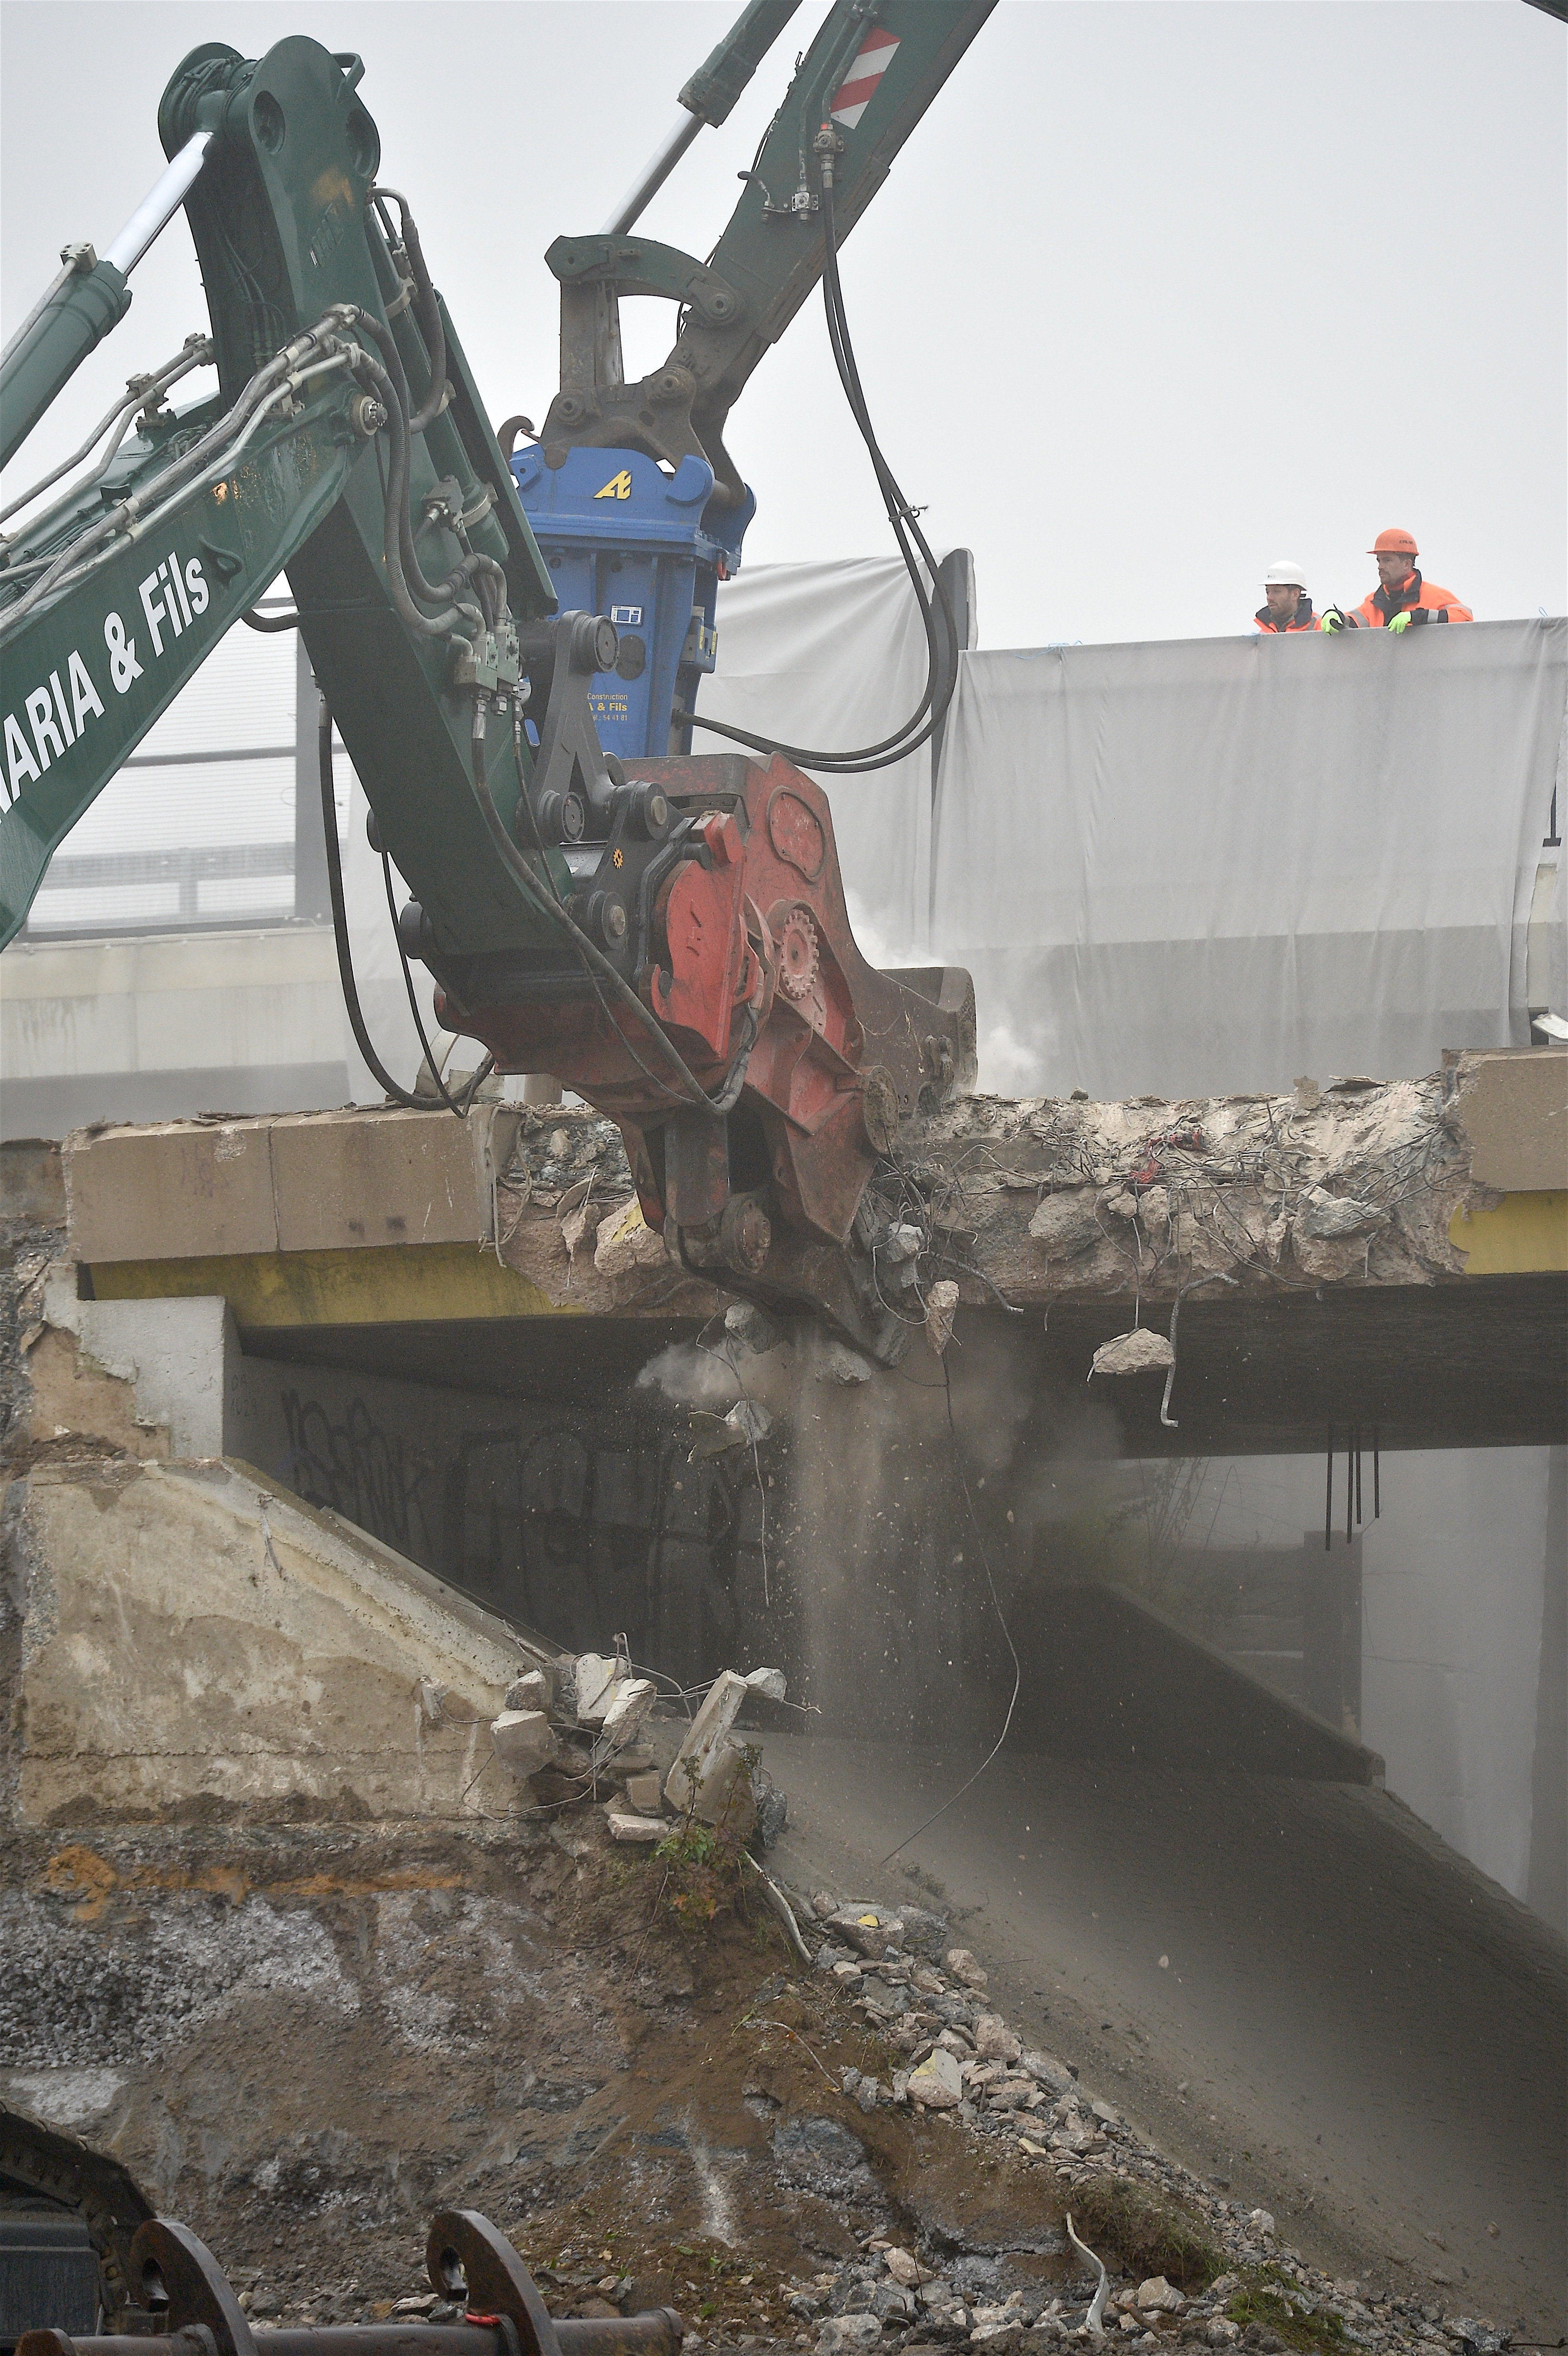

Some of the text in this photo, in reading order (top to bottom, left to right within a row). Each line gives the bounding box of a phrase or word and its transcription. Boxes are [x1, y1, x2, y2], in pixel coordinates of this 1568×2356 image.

[104, 611, 144, 694] &
[138, 551, 209, 657] Fils
[597, 702, 606, 711] &
[609, 702, 627, 711] Fils
